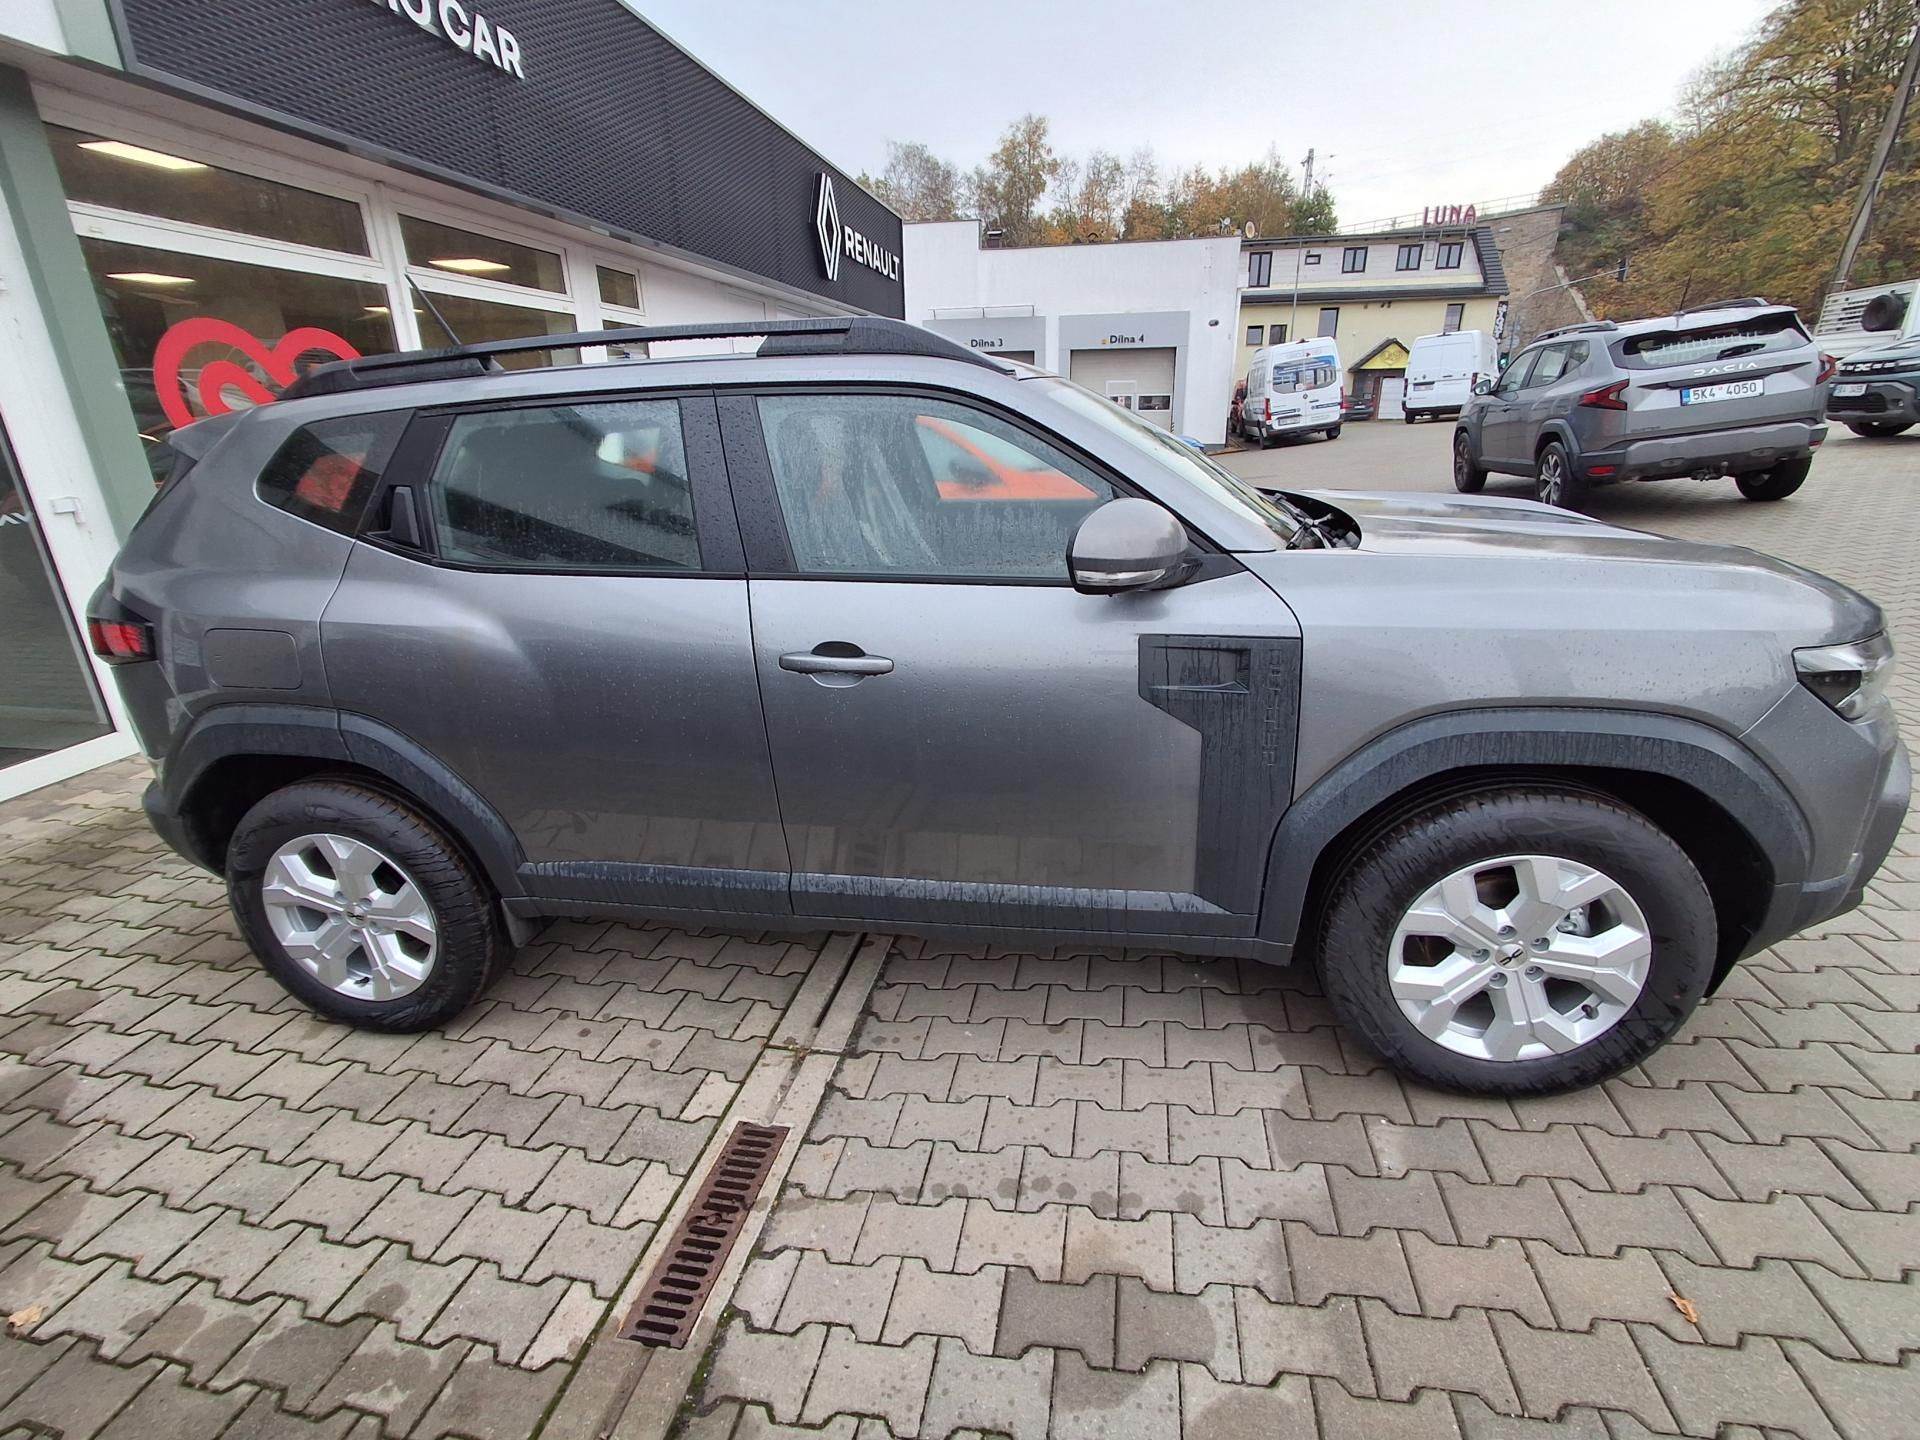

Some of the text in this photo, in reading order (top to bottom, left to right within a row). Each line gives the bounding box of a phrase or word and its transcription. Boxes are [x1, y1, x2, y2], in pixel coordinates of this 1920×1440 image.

[438, 0, 525, 79] CAR
[1423, 204, 1477, 225] LUNA
[844, 224, 900, 281] RENAULT
[997, 337, 1004, 347] 3
[1138, 333, 1145, 343] 4
[1693, 362, 1758, 376] DACIA
[1692, 382, 1757, 401] 5K4 4050
